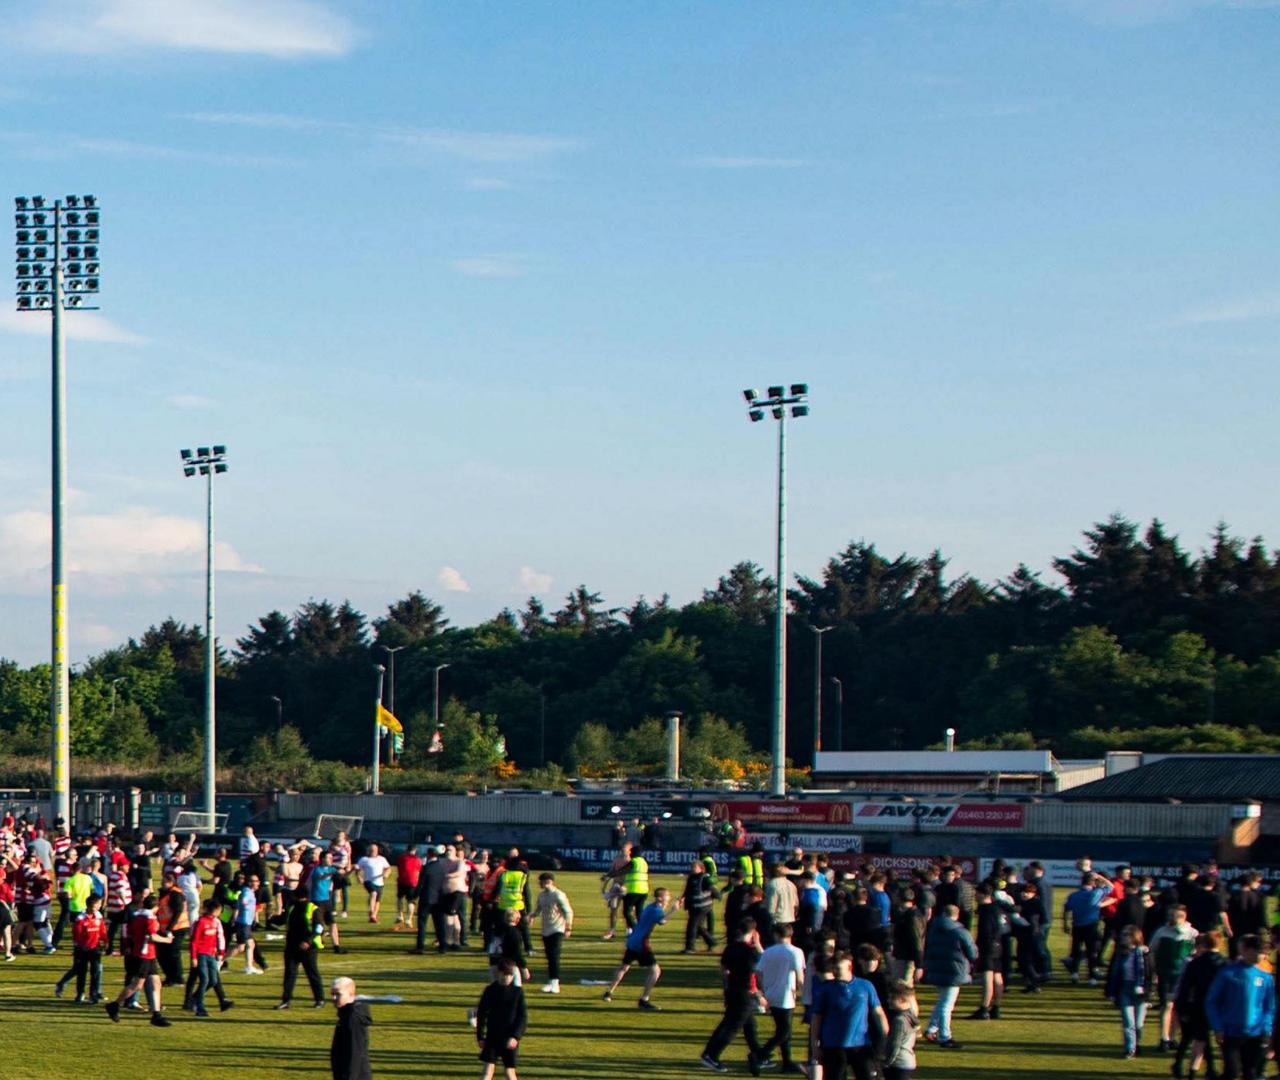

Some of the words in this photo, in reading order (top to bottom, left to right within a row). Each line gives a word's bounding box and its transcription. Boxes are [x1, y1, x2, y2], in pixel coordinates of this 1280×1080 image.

[878, 805, 955, 817] AVON
[815, 836, 861, 849] ACADEMY
[873, 857, 933, 869] DICKSONS
